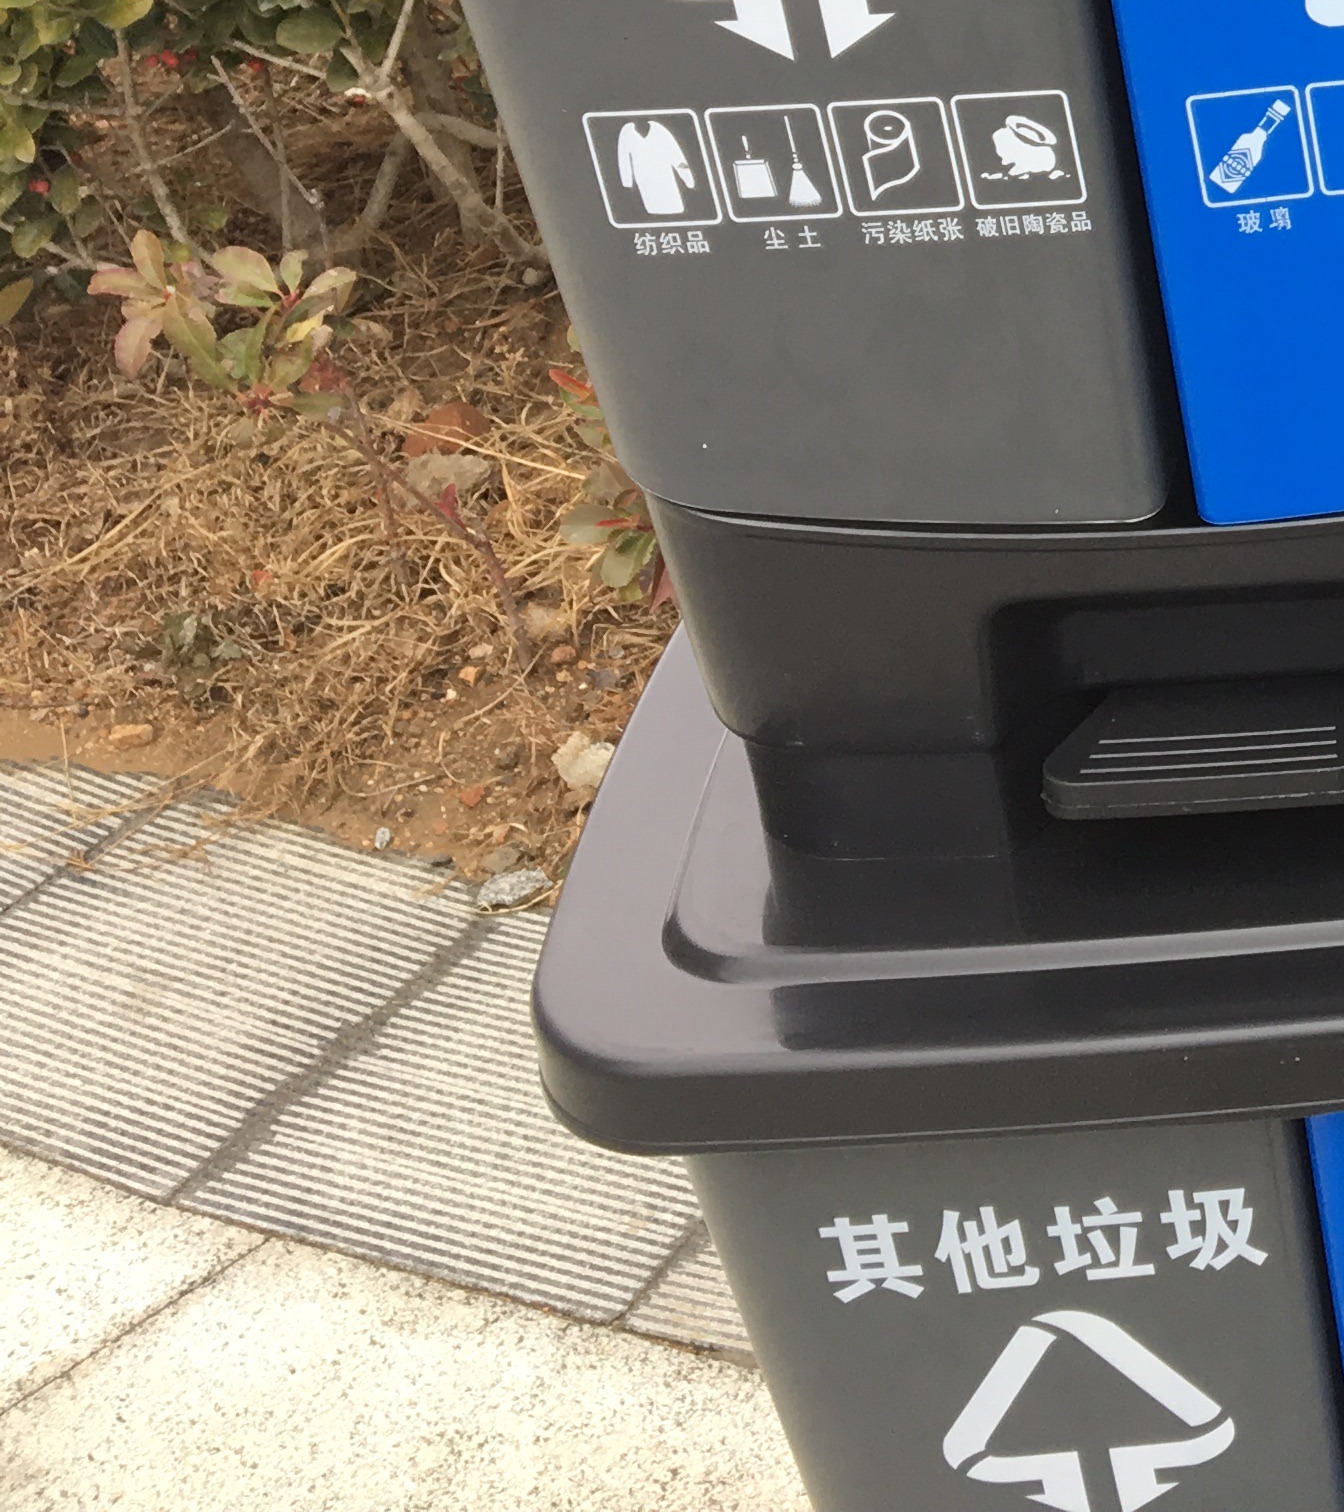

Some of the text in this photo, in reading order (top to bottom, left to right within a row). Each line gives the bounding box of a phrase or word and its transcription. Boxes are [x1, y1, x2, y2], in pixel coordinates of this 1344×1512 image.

[634, 211, 1093, 256] 纺织品 尘土 污染纸张 破旧陶瓷品
[1236, 207, 1292, 234] 玻璃
[818, 1187, 1269, 1304] 其他垃圾
